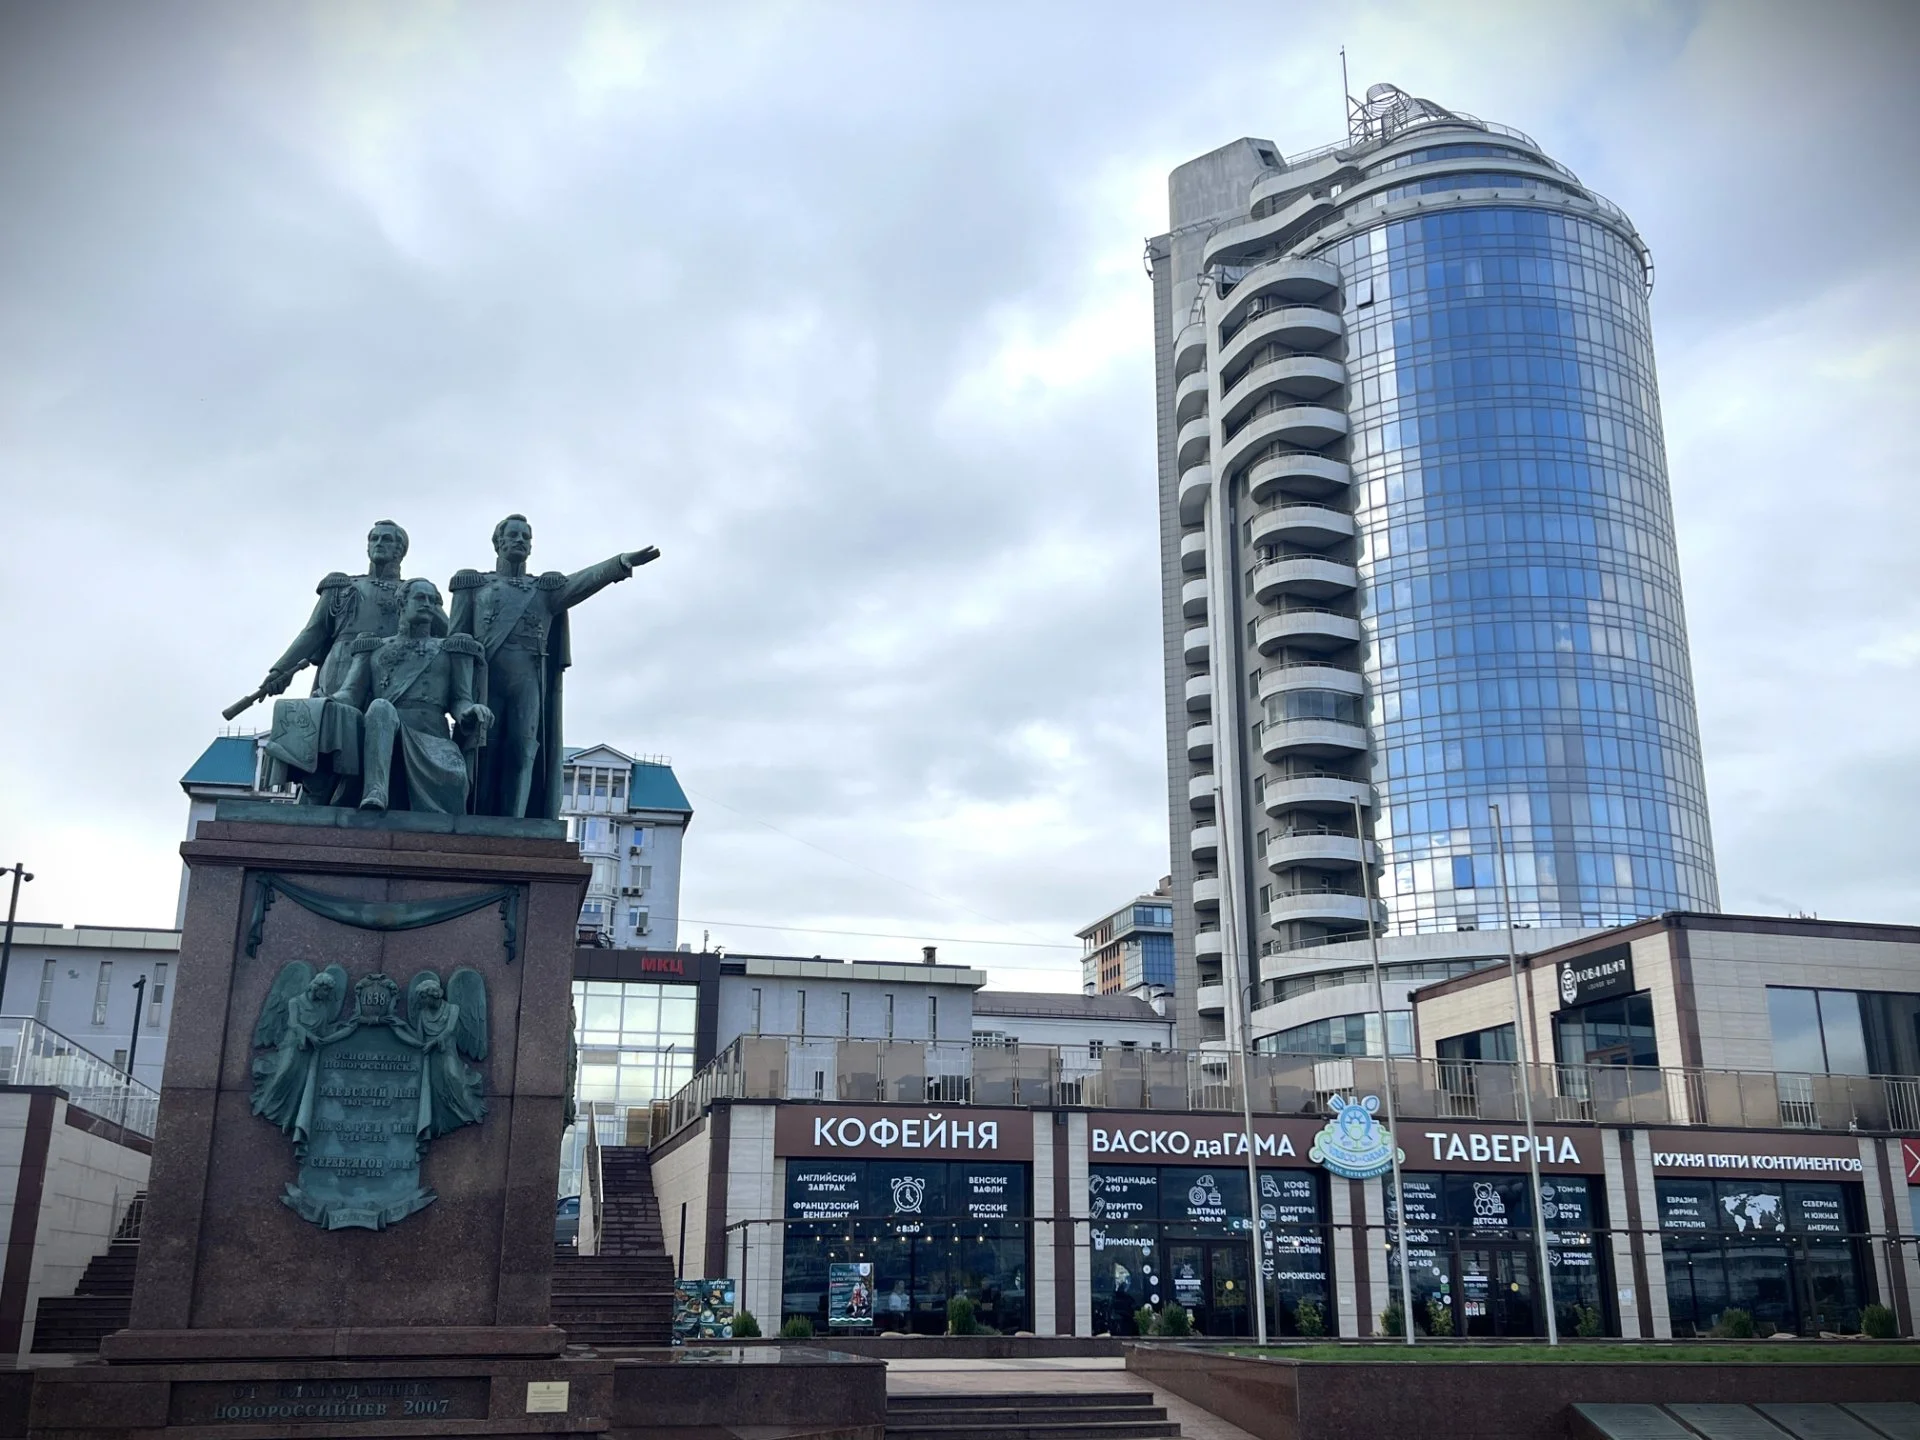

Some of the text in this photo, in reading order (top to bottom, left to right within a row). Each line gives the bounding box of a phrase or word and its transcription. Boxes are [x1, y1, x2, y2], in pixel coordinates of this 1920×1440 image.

[641, 957, 685, 976] МКЦ
[361, 992, 386, 1006] 1838
[334, 1051, 411, 1062] ОСНОВАТЕЛИ
[320, 1086, 387, 1098] РАЕВСКИЙ
[315, 1121, 383, 1133] ЛАЗАРЕВ
[814, 1113, 998, 1150] КОФЕЙНЯ
[1092, 1128, 1191, 1155] ВАСКО
[1424, 1132, 1581, 1164] ТАВЕРНА
[311, 1157, 383, 1169] СЕРЕБРЯКОВ
[1653, 1152, 1863, 1172] КУХНЯ ПЯТИ КОНТИНЕНТОВ
[797, 1172, 857, 1182] АНГЛИЙСКИЙ
[968, 1176, 1008, 1184] ВЕНСКИЕ
[1105, 1176, 1157, 1185] ЭМПАНАДАС
[808, 1183, 846, 1191] ЗАВТРАК
[1283, 1181, 1310, 1189] КОФЕ
[1403, 1182, 1430, 1191] ПИЦЦА
[1556, 1185, 1586, 1193] ТОМ-ЯМ
[1666, 1196, 1698, 1204] ЕВРАЗИЯ
[1802, 1200, 1838, 1209] СЕВЕРНАЯ
[792, 1200, 860, 1210] ФРАНЦУЗСКИЙ
[968, 1203, 1008, 1212] РУССКИЕ
[1106, 1202, 1143, 1210] БУРИТТО
[1280, 1205, 1315, 1214] БУРГЕРЫ
[1558, 1203, 1582, 1212] БОРЩ
[803, 1211, 850, 1219] БЕНЕДИКТ
[1187, 1207, 1227, 1216] ЗАВТРАКИ
[1668, 1209, 1699, 1217] АФРИКА
[1811, 1212, 1839, 1220] ЮЖНАЯ
[1280, 1215, 1299, 1223] ФРИ
[1472, 1217, 1508, 1226] ДЕТСКАЯ
[1242, 1218, 1267, 1230] 8:0
[1664, 1220, 1706, 1229] АВСТРАЛИЯ
[1807, 1223, 1840, 1232] АМЕРИКА
[902, 1225, 920, 1233] 8:30
[1105, 1238, 1155, 1247] ЛИМОНАДЫ
[1276, 1235, 1323, 1244] МОЛОЧНЫЕ
[1571, 1237, 1585, 1245] 57
[1278, 1244, 1322, 1254] КОКТЕЙЛИ
[1408, 1249, 1436, 1257] РОЛЛЫ
[1562, 1251, 1593, 1259] КУРИНЫЕ
[1418, 1259, 1433, 1267] 450
[232, 1383, 433, 1400] ОТ БЛАГОДАРНЫХ
[213, 1399, 450, 1419] НОВОРОССИЙЦЕВ 2007
